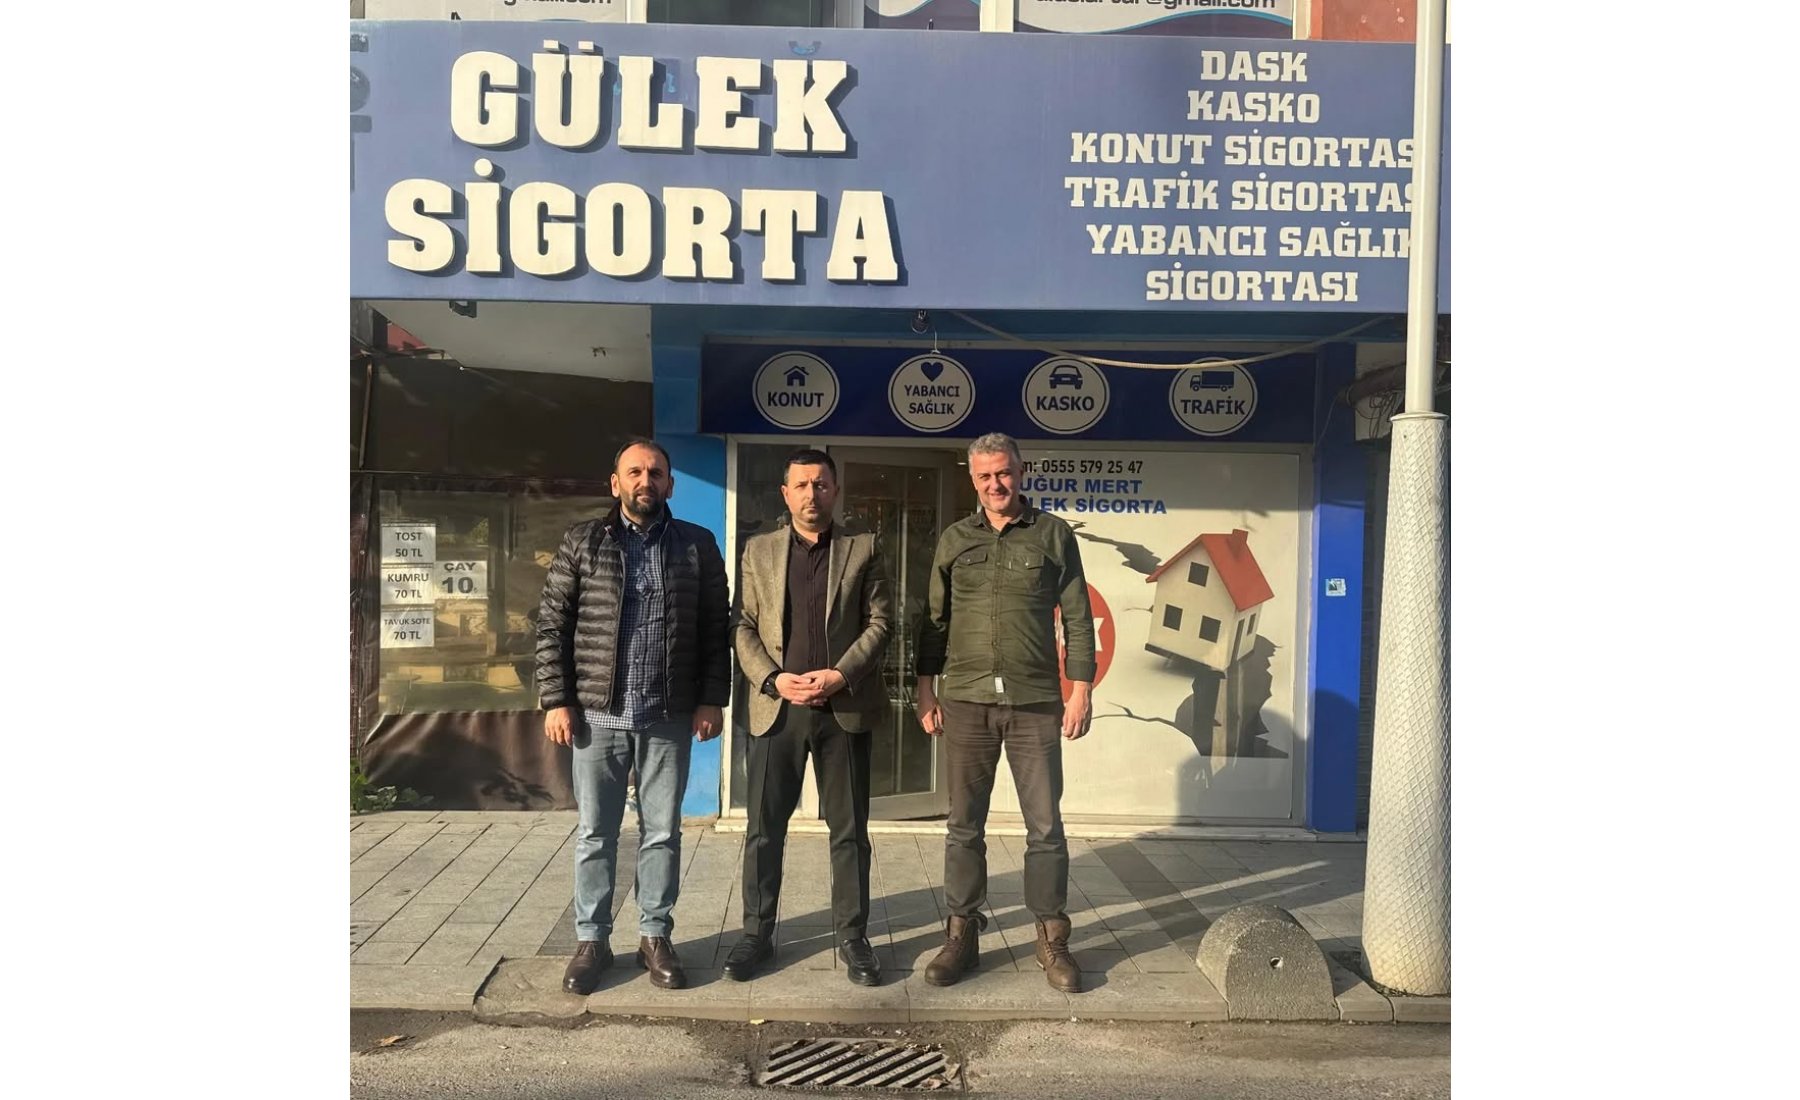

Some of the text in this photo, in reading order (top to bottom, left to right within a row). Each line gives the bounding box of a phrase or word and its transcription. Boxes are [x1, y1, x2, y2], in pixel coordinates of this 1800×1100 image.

[1200, 50, 1308, 82] DASK
[451, 39, 848, 152] GÜLEK
[1187, 90, 1321, 123] KASKO
[1070, 132, 1213, 165] KONUT
[1064, 170, 1219, 211] TRAFİK
[384, 158, 899, 281] SİGORTA
[1086, 224, 1267, 256] YABANCI
[1146, 261, 1358, 302] SİGORTASI
[767, 391, 824, 408] KONUT
[904, 384, 960, 398] YABANCI
[908, 399, 955, 415] SAĞLIK
[1036, 395, 1095, 411] KASKO
[1180, 395, 1246, 416] TRAFİK
[1041, 459, 1075, 473] 0555
[1080, 460, 1103, 474] 579
[1107, 460, 1123, 474] 25
[1128, 460, 1143, 474] 47
[1019, 475, 1143, 494] UĞUR MERT
[1075, 495, 1168, 515] SİGORTA
[395, 531, 424, 541] TOST
[395, 548, 424, 558] 50 TL
[443, 562, 477, 574] ÇAY
[387, 573, 429, 583] KUMRU
[395, 589, 422, 599] 70 TL
[384, 617, 431, 626] TAVUK SOTE
[393, 631, 422, 640] 70 TL
